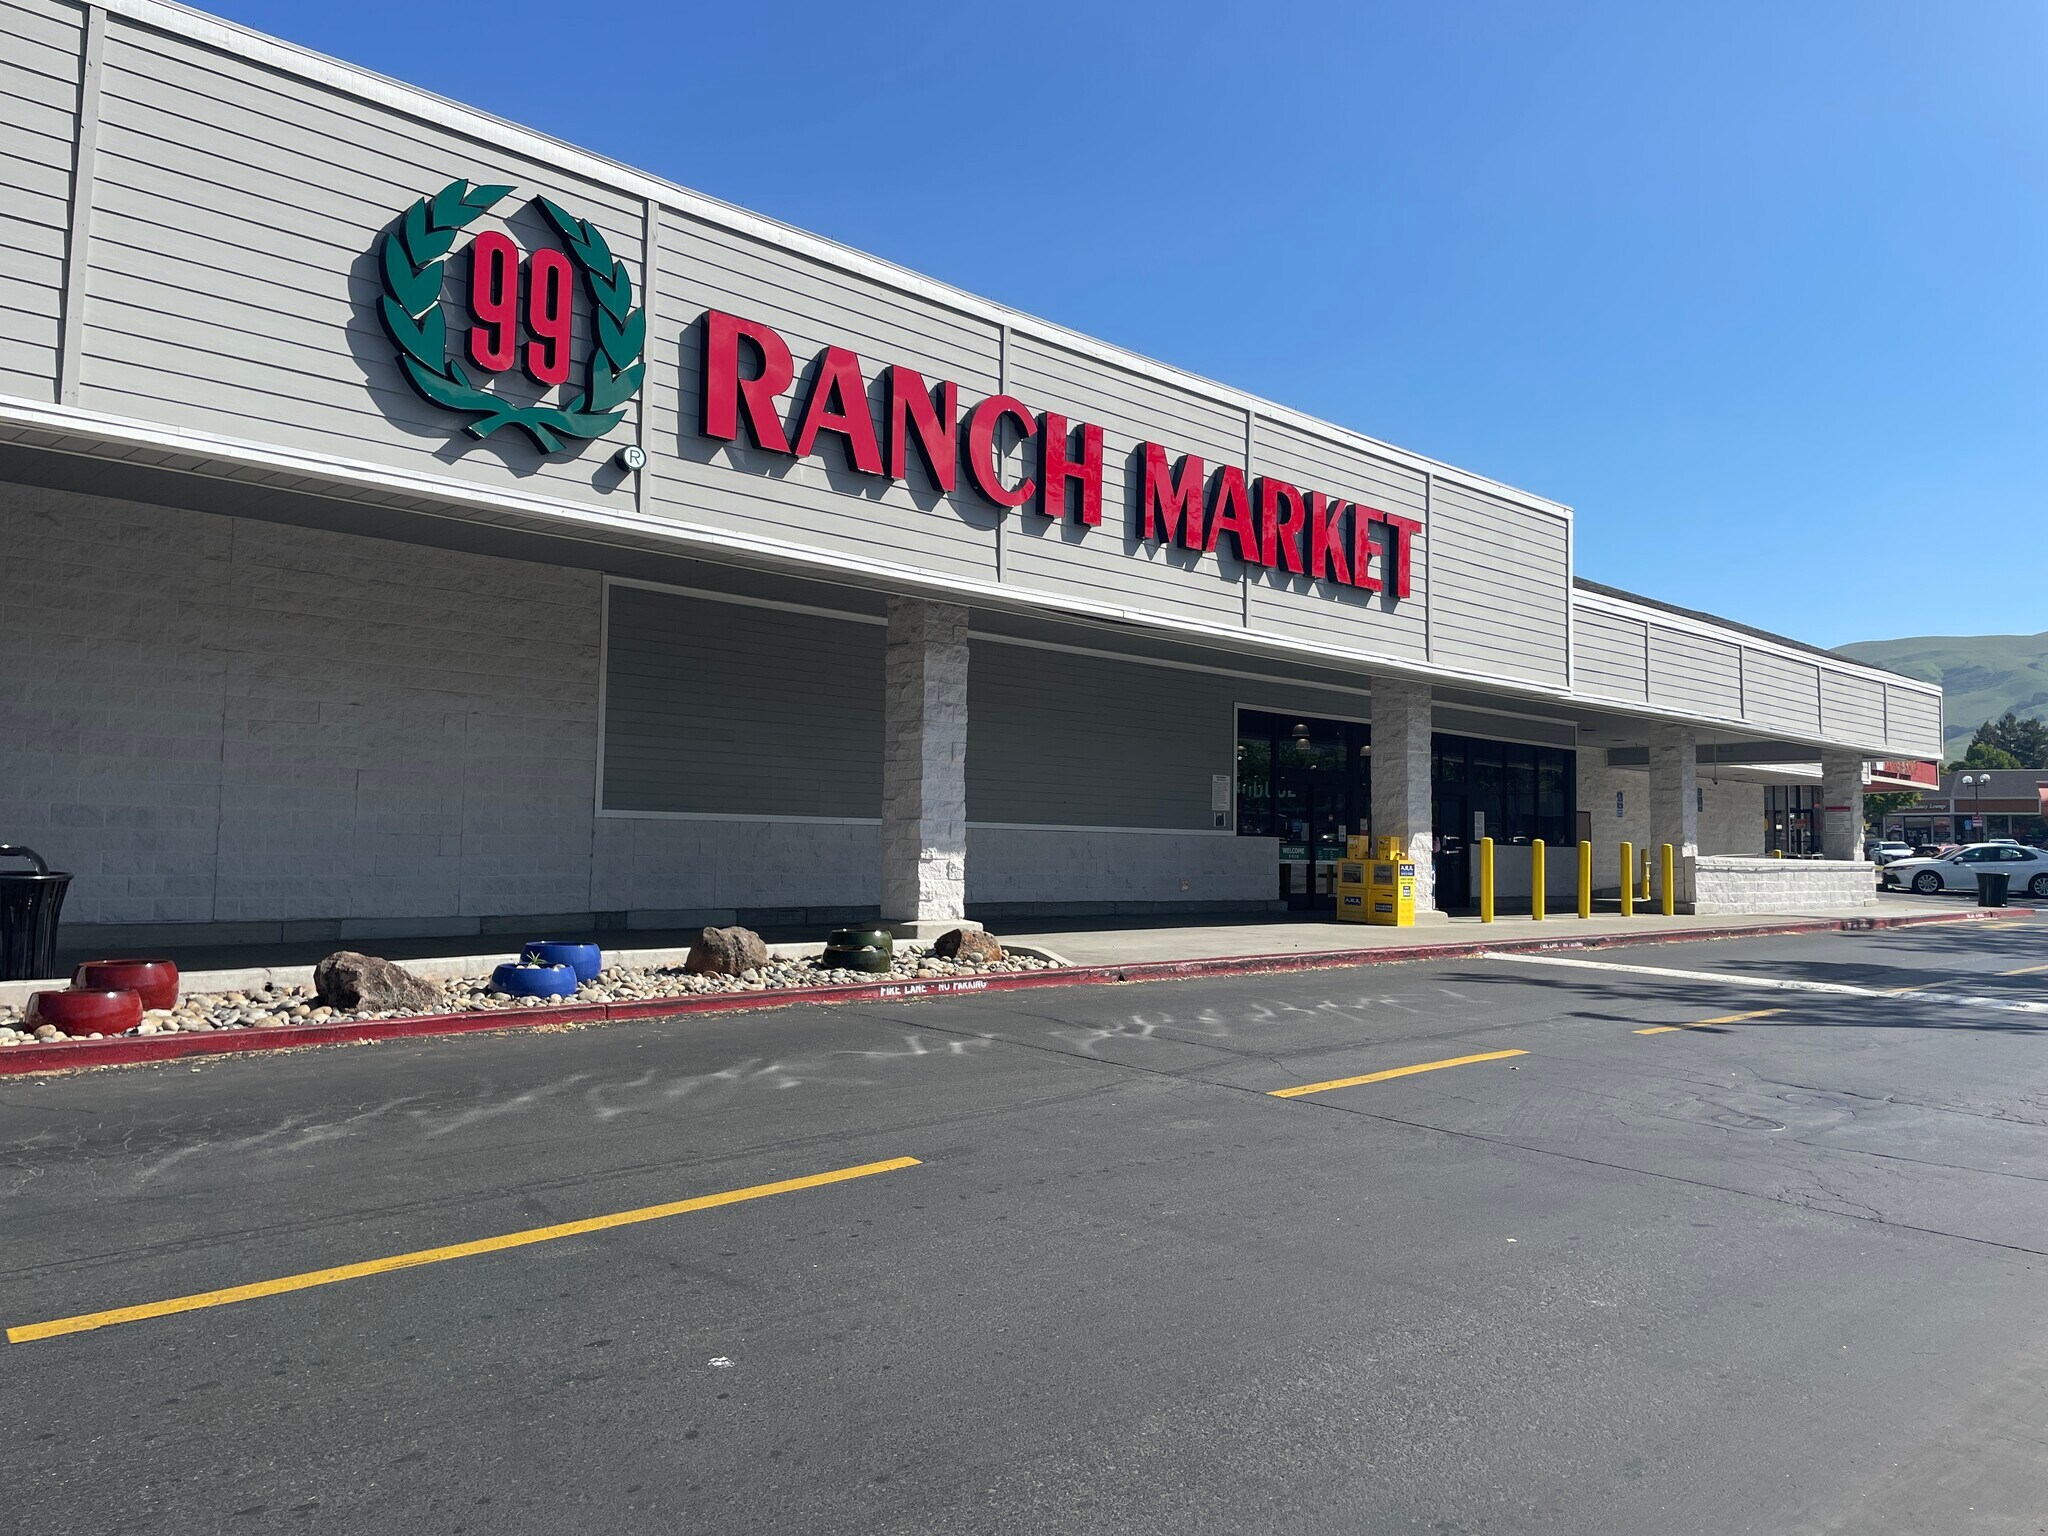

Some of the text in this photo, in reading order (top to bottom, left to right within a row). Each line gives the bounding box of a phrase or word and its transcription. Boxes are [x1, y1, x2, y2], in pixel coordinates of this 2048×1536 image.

[468, 231, 573, 385] 99
[704, 309, 1422, 599] RANCH MARKET
[1282, 847, 1305, 855] WELCOME
[904, 984, 927, 995] LANE
